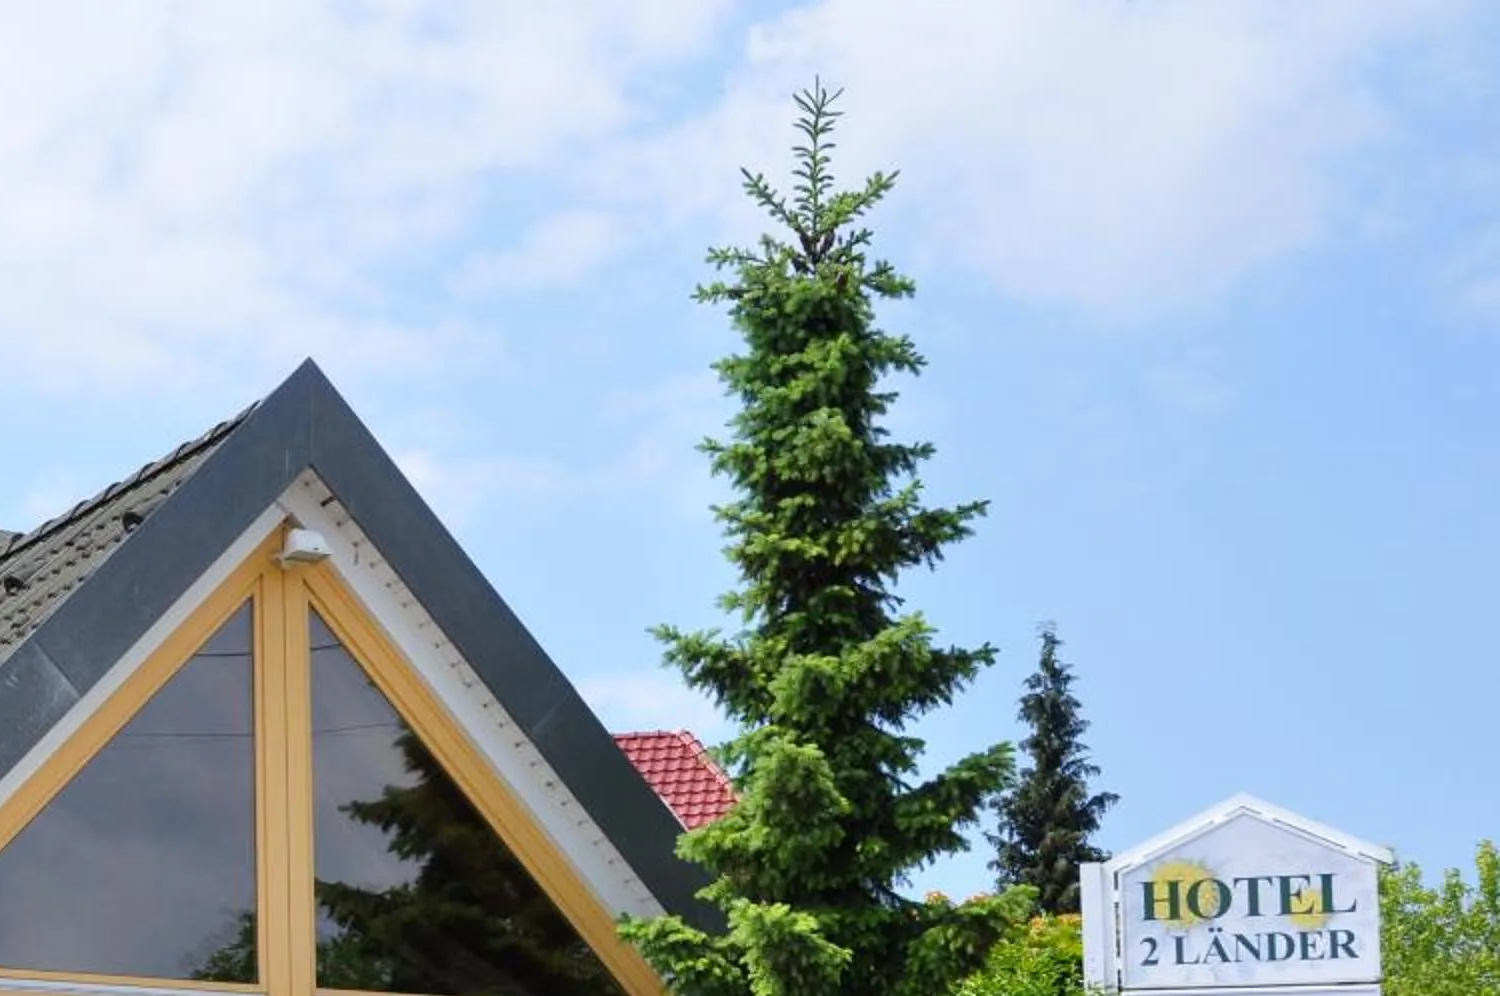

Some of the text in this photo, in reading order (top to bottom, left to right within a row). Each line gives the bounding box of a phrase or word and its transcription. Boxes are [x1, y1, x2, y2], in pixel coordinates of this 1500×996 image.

[1139, 873, 1357, 921] HOTEL
[1139, 927, 1359, 966] 2 LÄNDER
